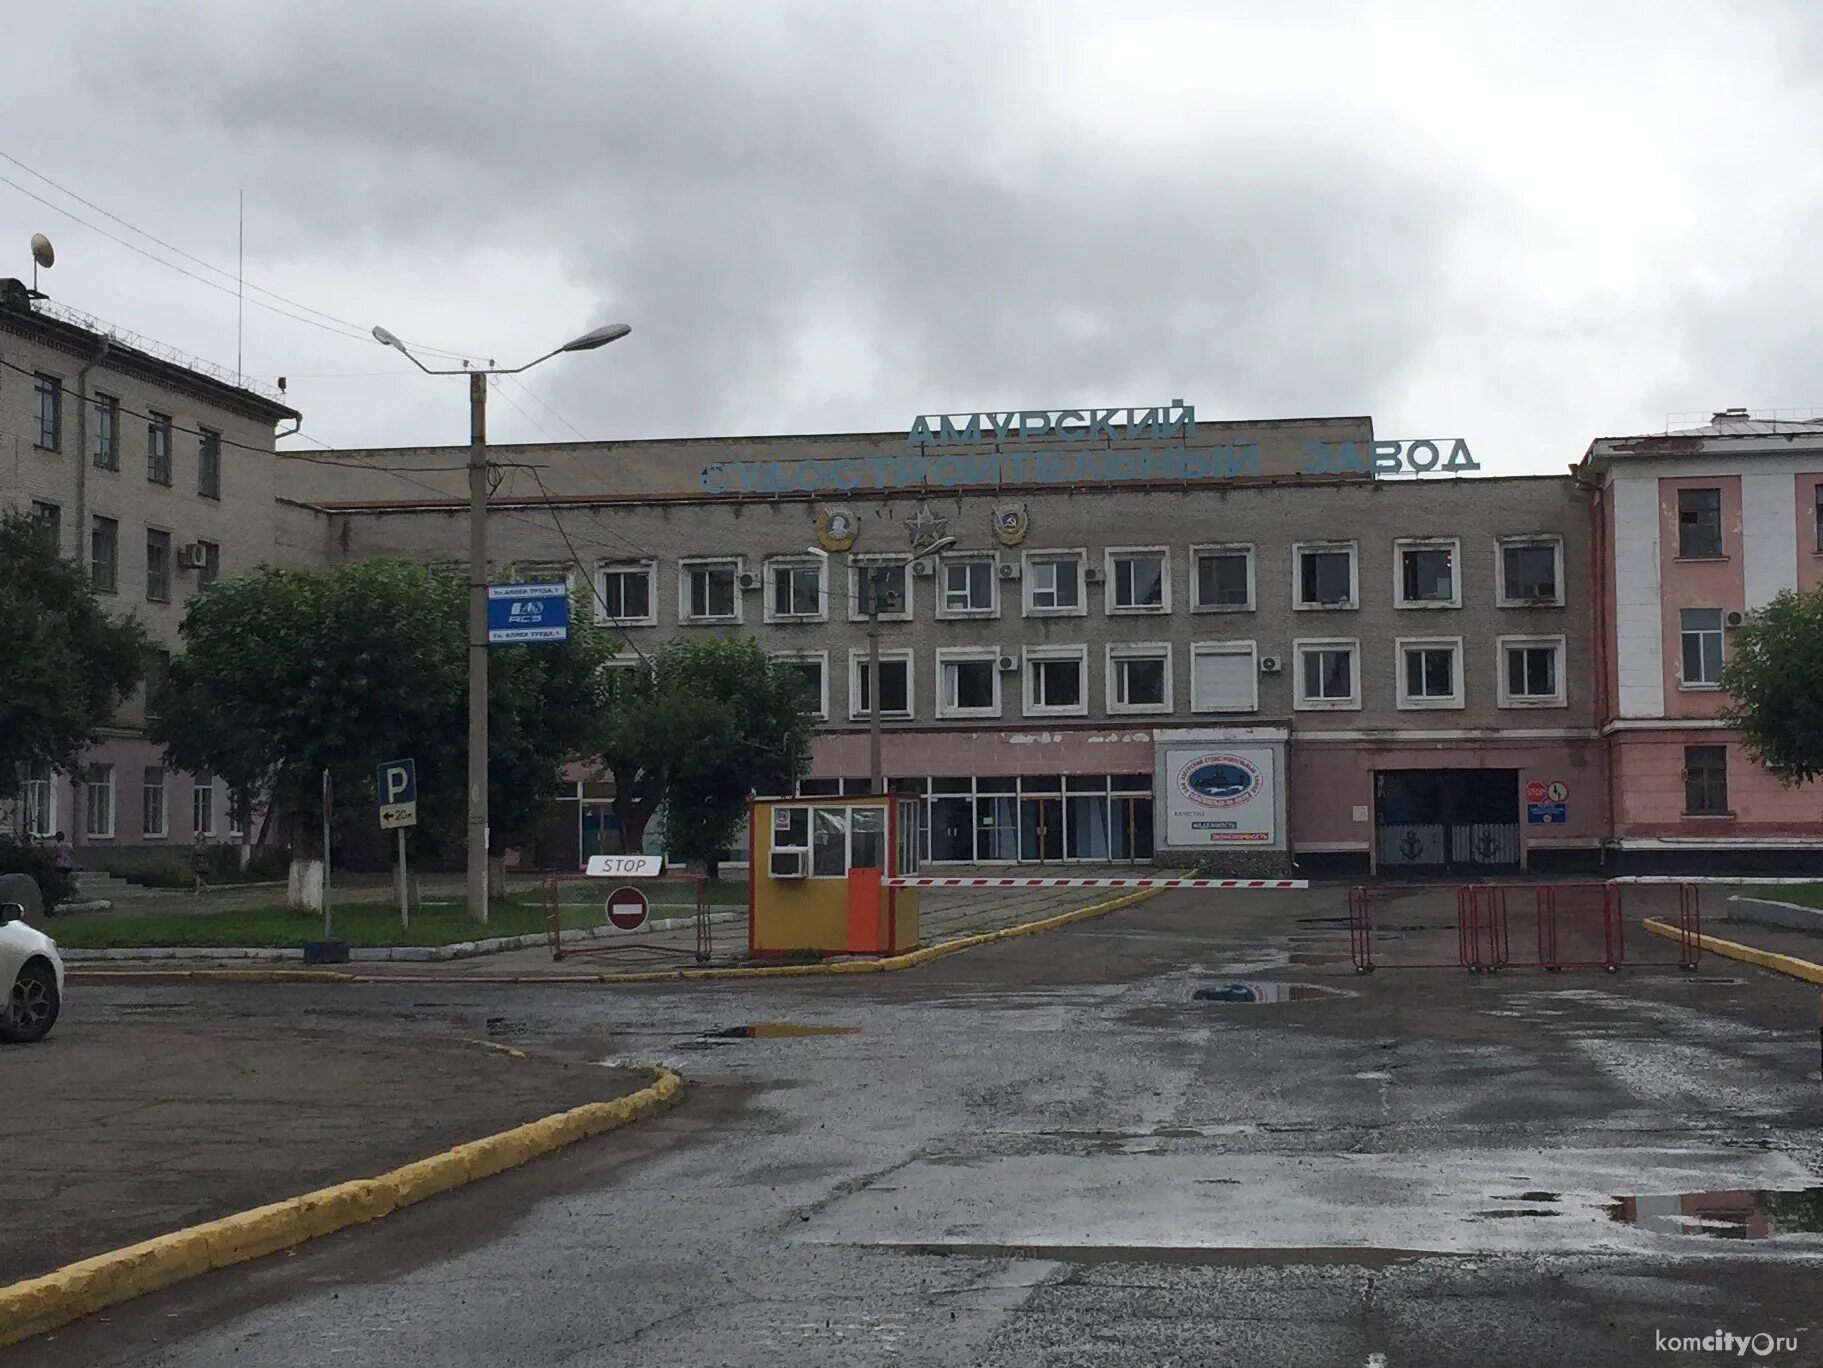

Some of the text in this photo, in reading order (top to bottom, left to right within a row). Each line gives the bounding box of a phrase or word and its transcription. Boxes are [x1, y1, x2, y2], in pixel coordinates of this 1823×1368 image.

[906, 399, 1196, 447] АМУРСКИЙ
[701, 436, 1480, 493] СУДОСТРОИТЕЛЬНЫЙ ЗАВОД
[387, 767, 408, 803] P
[602, 859, 646, 872] STOP
